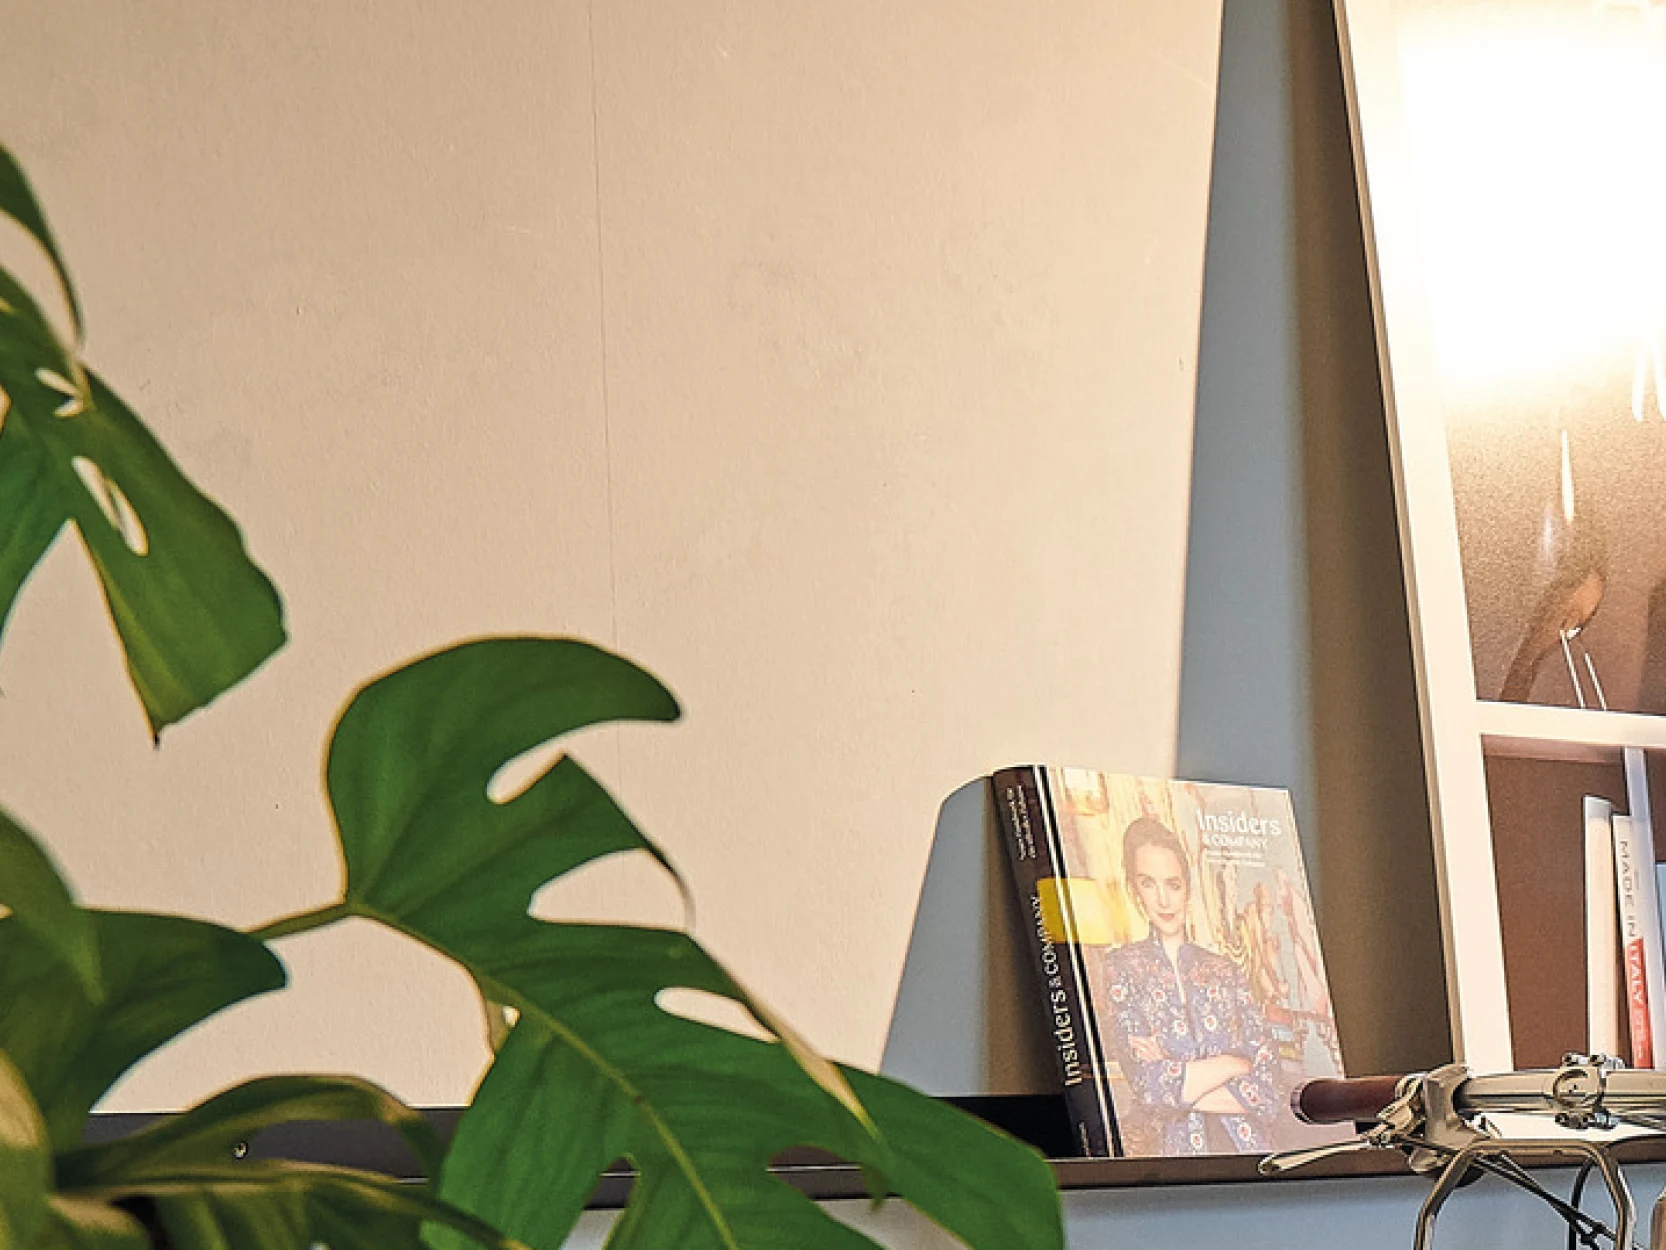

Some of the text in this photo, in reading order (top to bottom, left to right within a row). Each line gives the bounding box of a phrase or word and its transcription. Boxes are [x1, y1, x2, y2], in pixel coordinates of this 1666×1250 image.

[1196, 808, 1281, 835] Insiders
[1619, 839, 1636, 908] MADE
[1630, 943, 1643, 1005] ITALY
[1050, 989, 1084, 1086] Insiders
